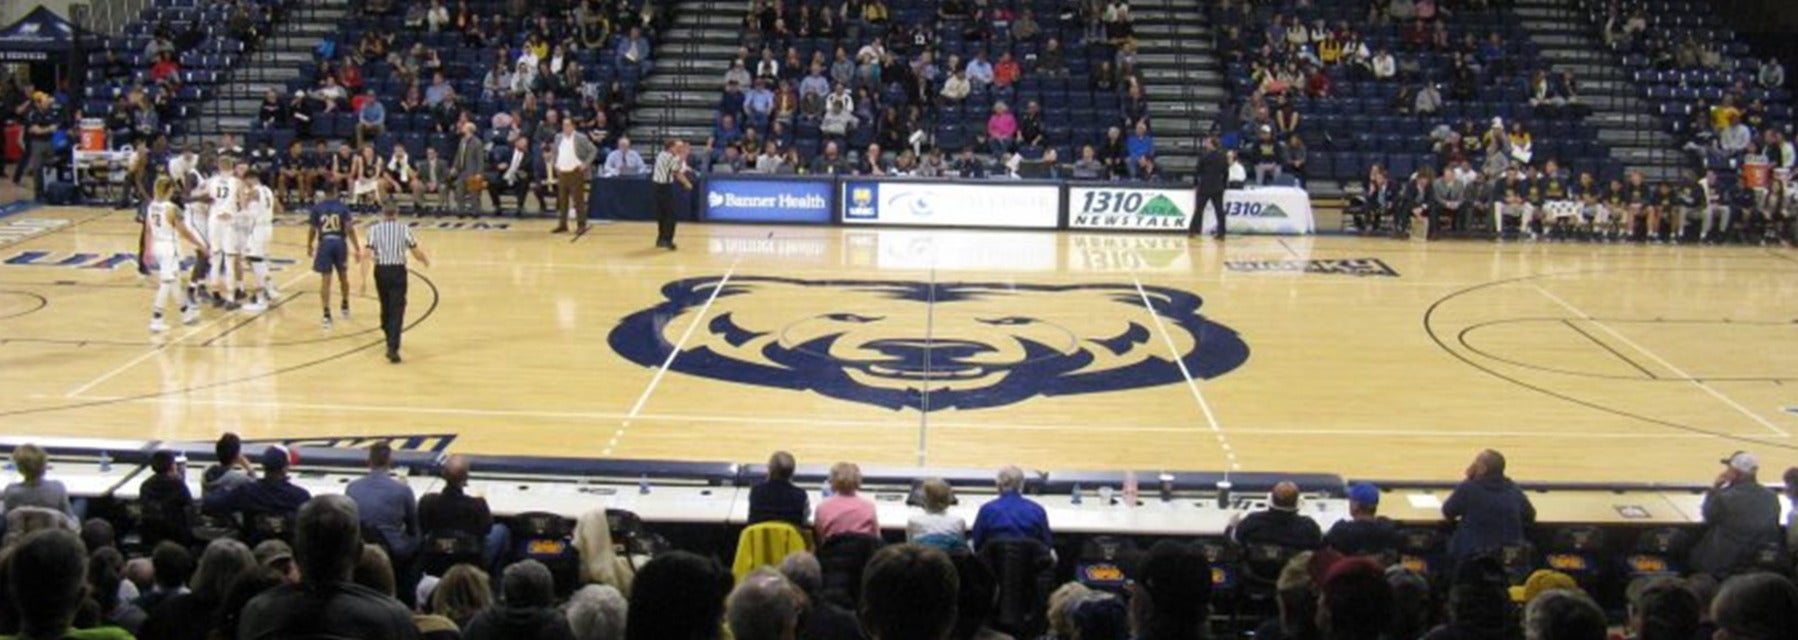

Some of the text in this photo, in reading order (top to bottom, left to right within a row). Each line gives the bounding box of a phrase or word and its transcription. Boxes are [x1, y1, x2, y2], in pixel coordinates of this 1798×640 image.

[725, 193, 826, 208] Banner Health
[1083, 191, 1143, 213] 1310
[1225, 202, 1262, 216] 1310
[319, 214, 340, 233] 20
